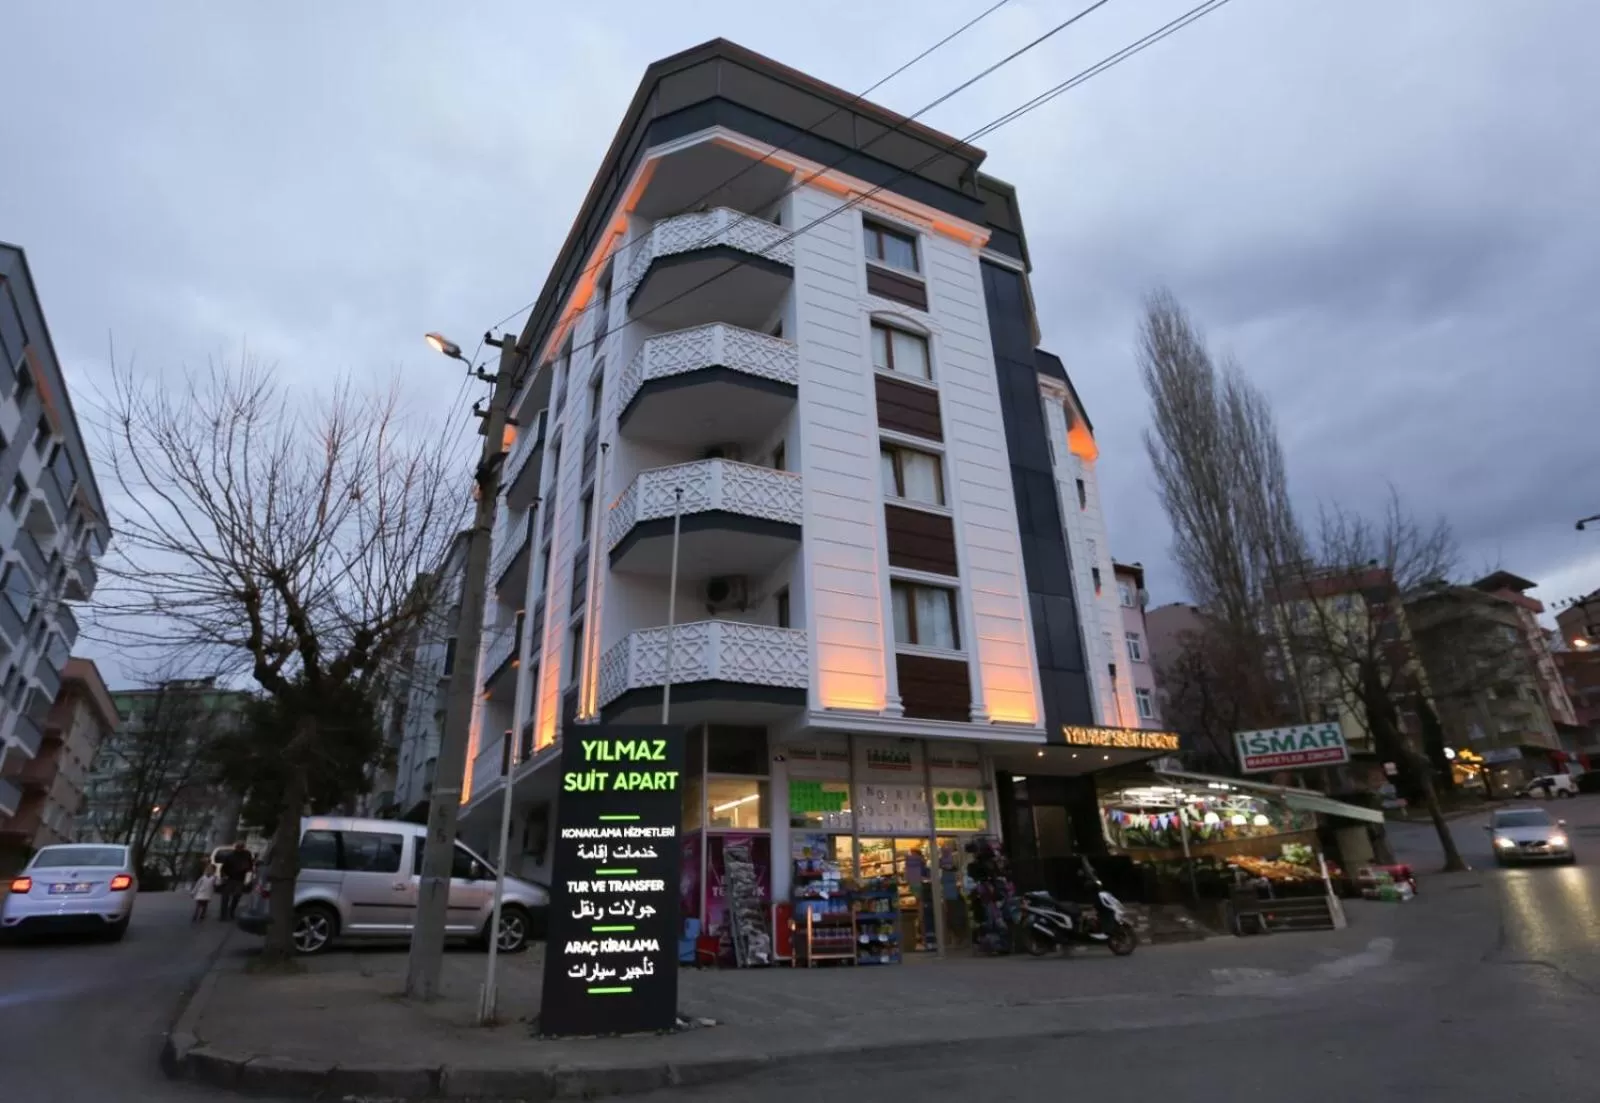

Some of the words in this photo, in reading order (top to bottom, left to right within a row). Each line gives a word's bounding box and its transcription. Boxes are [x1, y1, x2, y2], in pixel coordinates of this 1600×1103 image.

[581, 739, 667, 761] YILMAZ
[564, 768, 609, 791] SUİT
[613, 771, 679, 791] APART
[561, 828, 622, 838] KONAKLAMA
[623, 825, 676, 838] HİZMETLERİ
[577, 844, 608, 864] إقامة
[612, 844, 658, 858] خدمات
[567, 881, 589, 893] TUR
[591, 881, 606, 892] VE
[608, 879, 665, 892] TRANSFER
[572, 899, 604, 920] ونقل
[608, 899, 657, 919] جولات
[564, 940, 599, 956] ARAÇ
[600, 937, 660, 953] KİRALAMA
[567, 962, 616, 982] سيارات
[619, 956, 654, 980] تأجير
